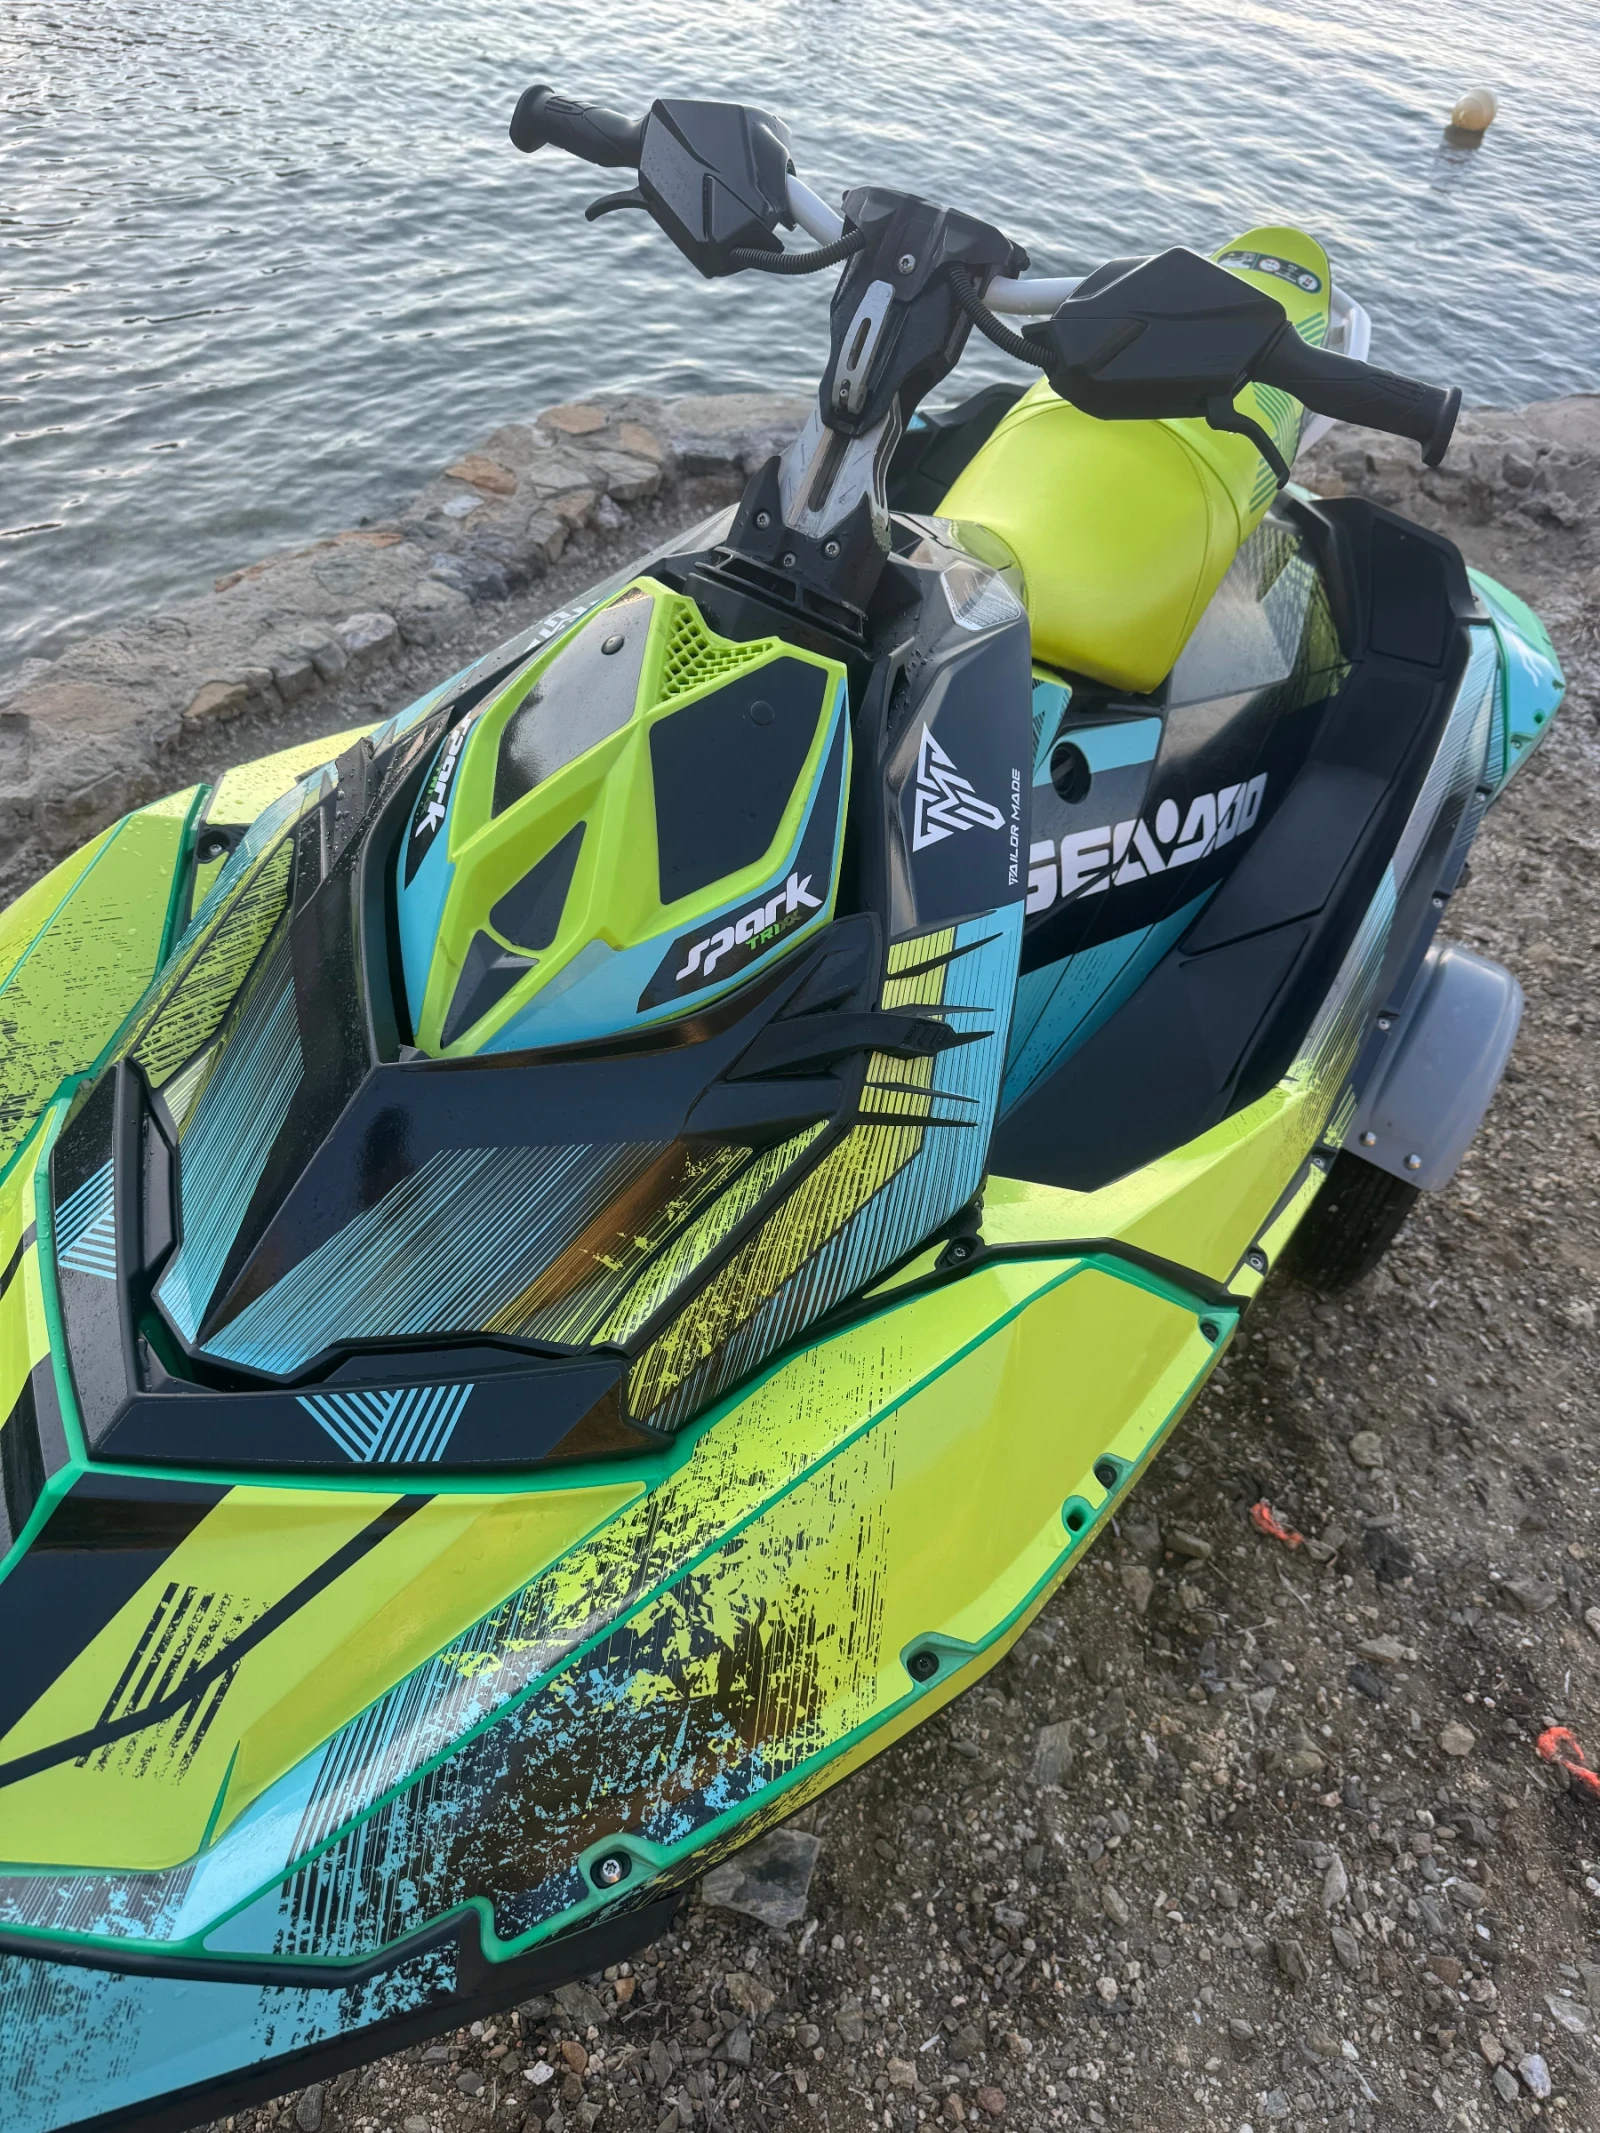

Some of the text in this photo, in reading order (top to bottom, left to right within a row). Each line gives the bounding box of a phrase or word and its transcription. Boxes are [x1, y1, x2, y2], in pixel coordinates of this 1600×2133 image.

[1008, 768, 1020, 886] TAILOR MADE
[745, 909, 802, 950] TRIXX
